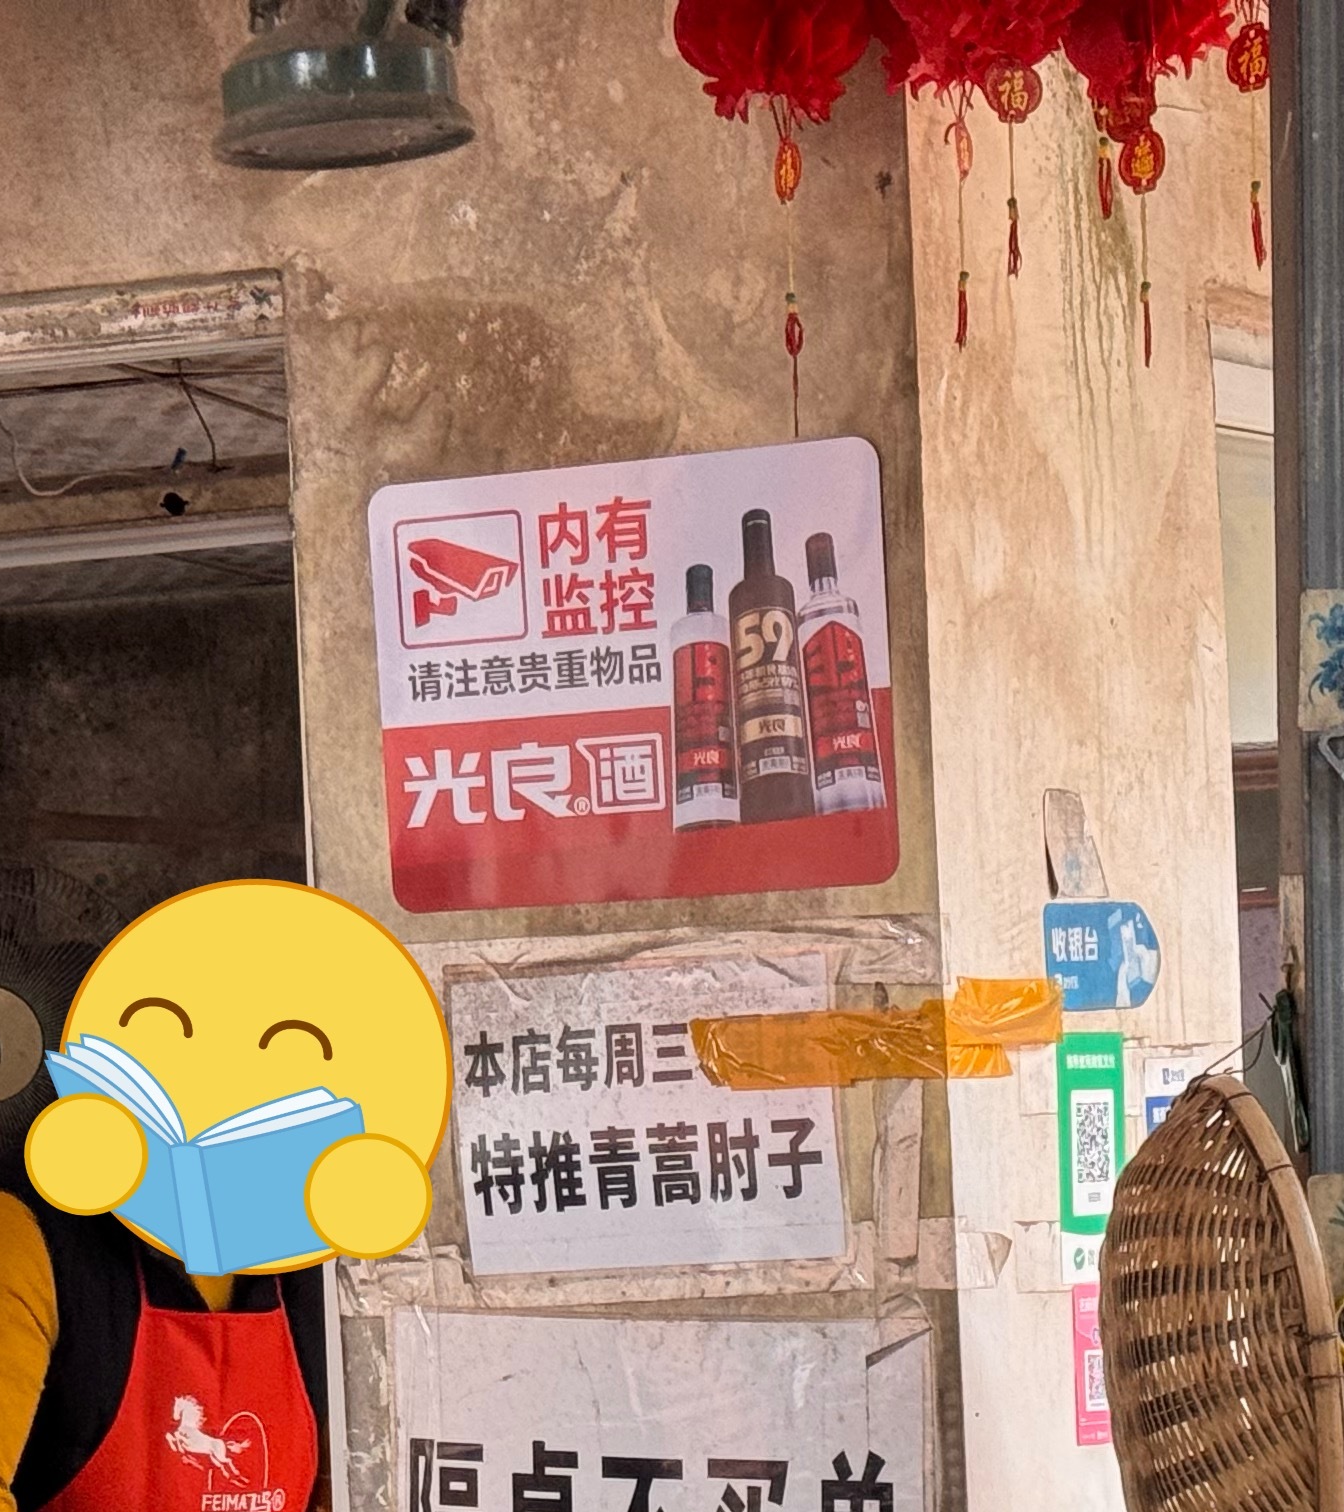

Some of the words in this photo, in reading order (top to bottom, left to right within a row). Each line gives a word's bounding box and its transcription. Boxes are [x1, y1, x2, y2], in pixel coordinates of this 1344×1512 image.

[1238, 37, 1267, 76] 福
[998, 68, 1028, 113] 福
[538, 497, 652, 568] 内有
[541, 568, 658, 639] 监控
[735, 610, 794, 669] 59
[408, 643, 663, 703] 请注意贵重物品
[1051, 926, 1098, 962] 收银台
[463, 1022, 694, 1098] 本店每周三
[471, 1117, 824, 1217] 特推青蒿肘子
